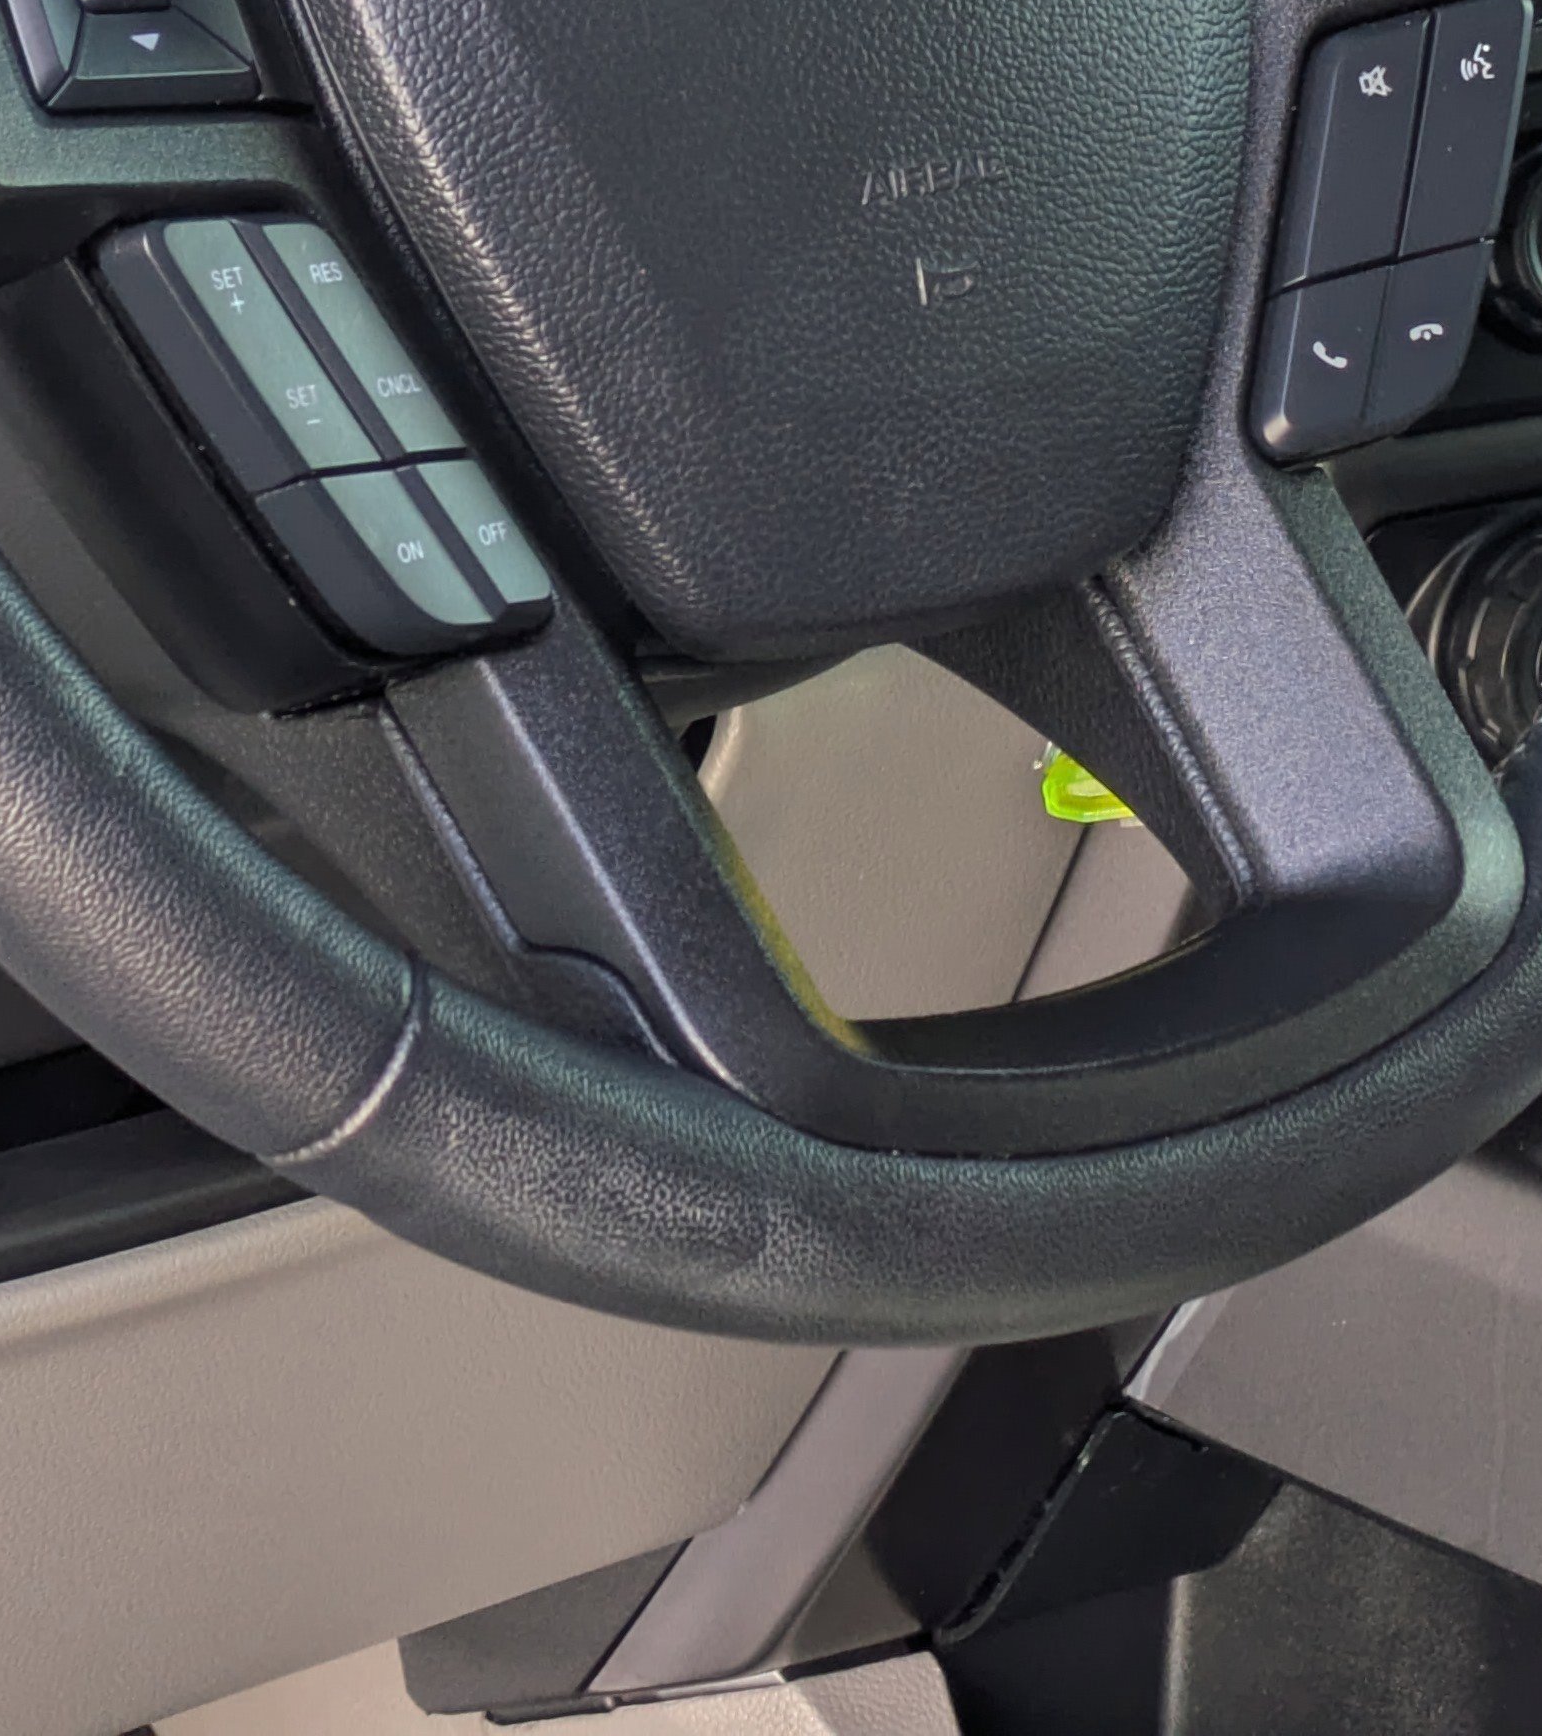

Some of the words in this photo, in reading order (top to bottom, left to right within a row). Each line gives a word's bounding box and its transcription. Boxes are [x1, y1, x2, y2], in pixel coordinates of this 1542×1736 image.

[211, 267, 243, 291] SET
[309, 262, 342, 284] RES
[286, 385, 316, 410] SET
[376, 374, 422, 398] CNCL
[479, 521, 508, 545] OFF
[397, 542, 424, 563] ON
